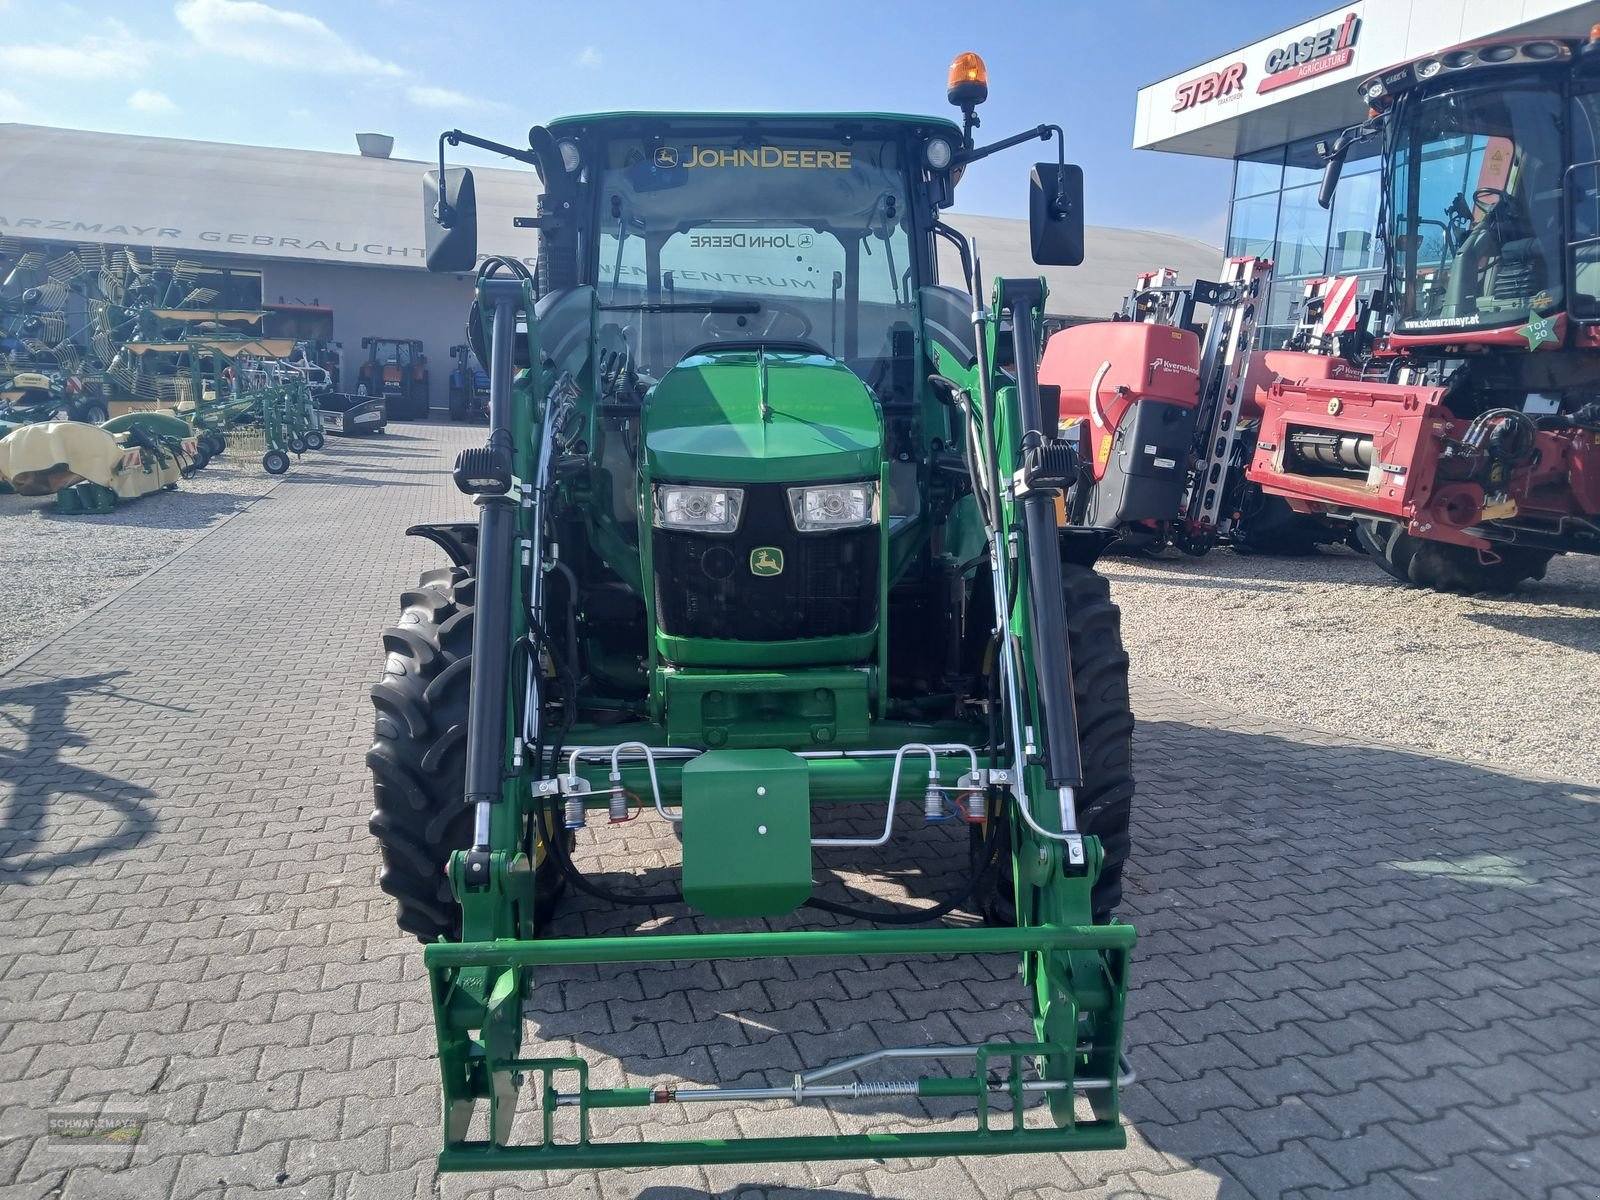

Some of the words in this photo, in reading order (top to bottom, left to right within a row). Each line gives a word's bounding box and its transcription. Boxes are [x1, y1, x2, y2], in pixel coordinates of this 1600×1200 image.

[1297, 50, 1348, 78] AGRICULTURE
[1171, 62, 1247, 112] STEYR
[1405, 313, 1480, 329] www.schwarzmayr.at
[1527, 319, 1549, 333] TOP
[1534, 329, 1548, 341] 20
[1163, 360, 1199, 376] Kverneland
